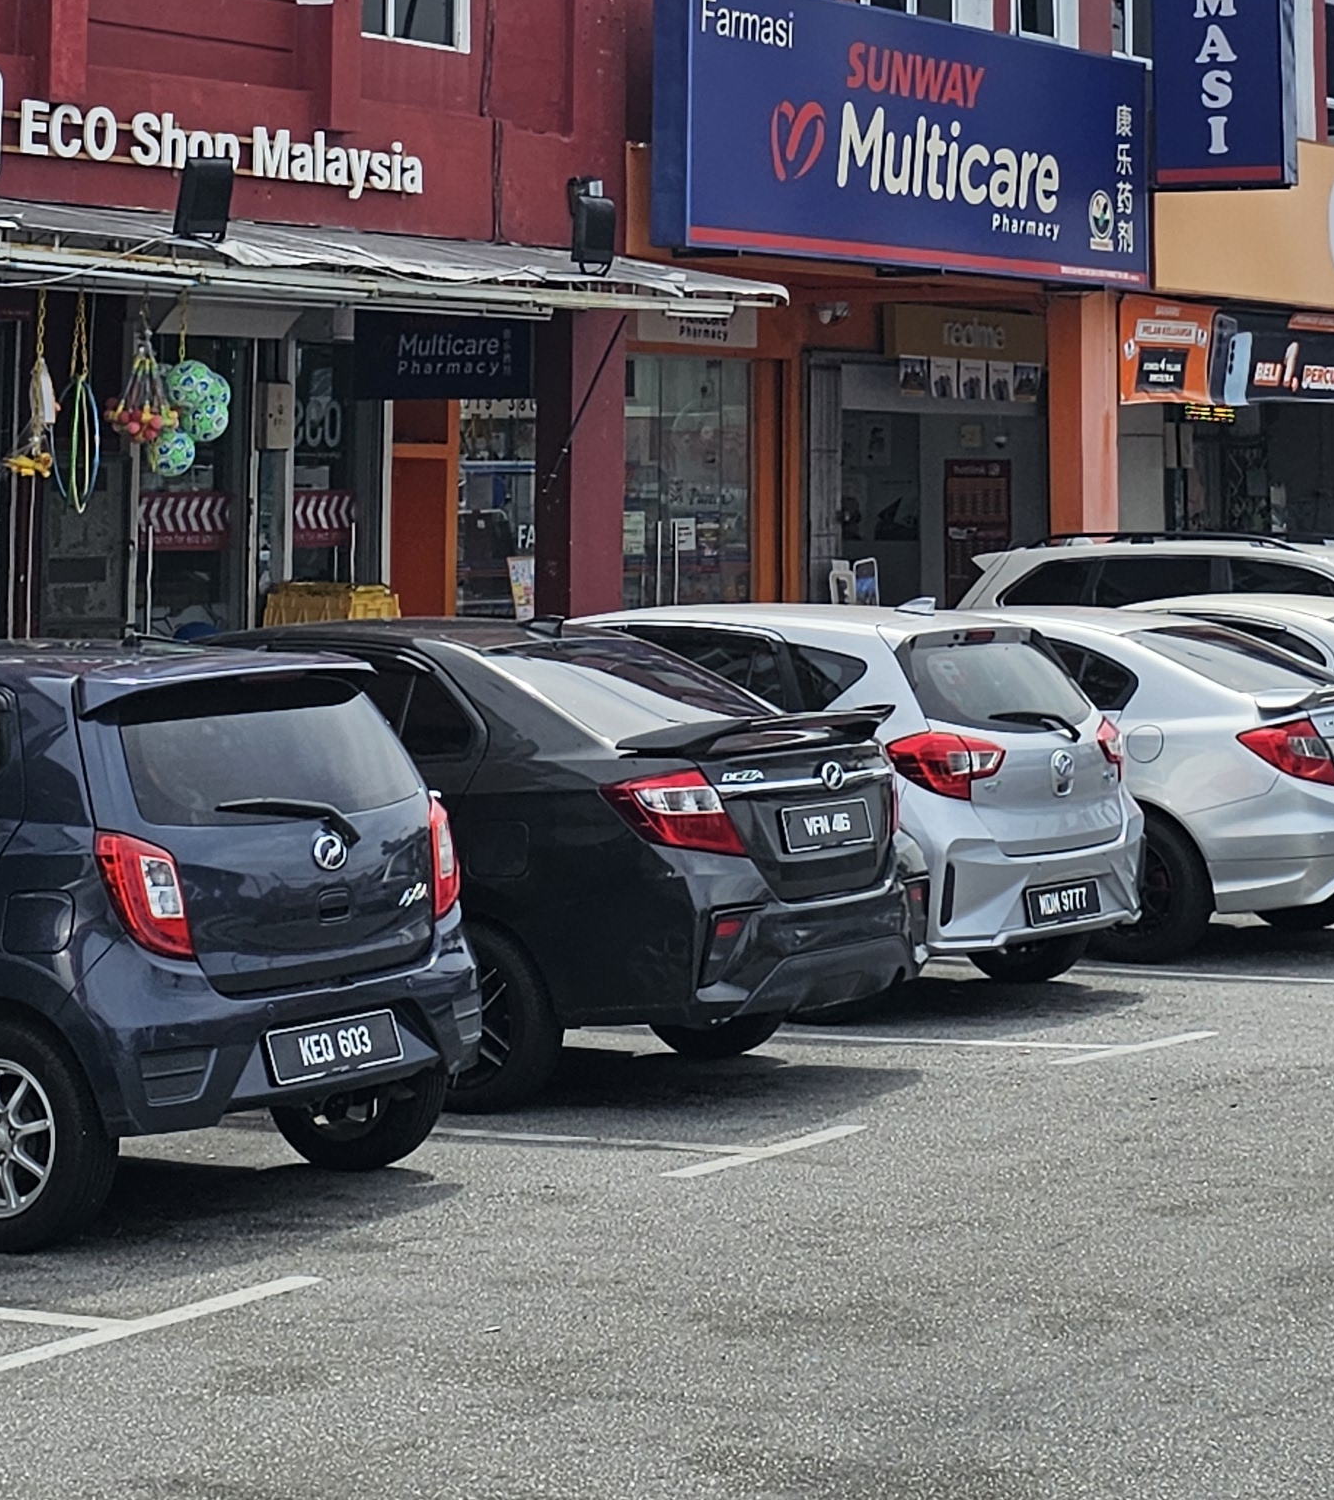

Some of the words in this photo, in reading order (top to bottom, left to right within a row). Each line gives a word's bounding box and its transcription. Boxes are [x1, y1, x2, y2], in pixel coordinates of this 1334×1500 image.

[846, 41, 987, 109] SUNWAY
[19, 98, 117, 162] ECO
[251, 126, 424, 199] Malaysia
[835, 101, 1060, 214] Multicare
[1114, 104, 1134, 255] 康乐药剂
[991, 213, 1061, 243] Pharmacy
[397, 333, 500, 357] Multicare
[679, 325, 729, 342] Pharmacy
[397, 360, 501, 377] Pharmacy
[1061, 886, 1088, 912] 9777
[297, 1032, 335, 1067] KEQ
[338, 1025, 372, 1059] 603
